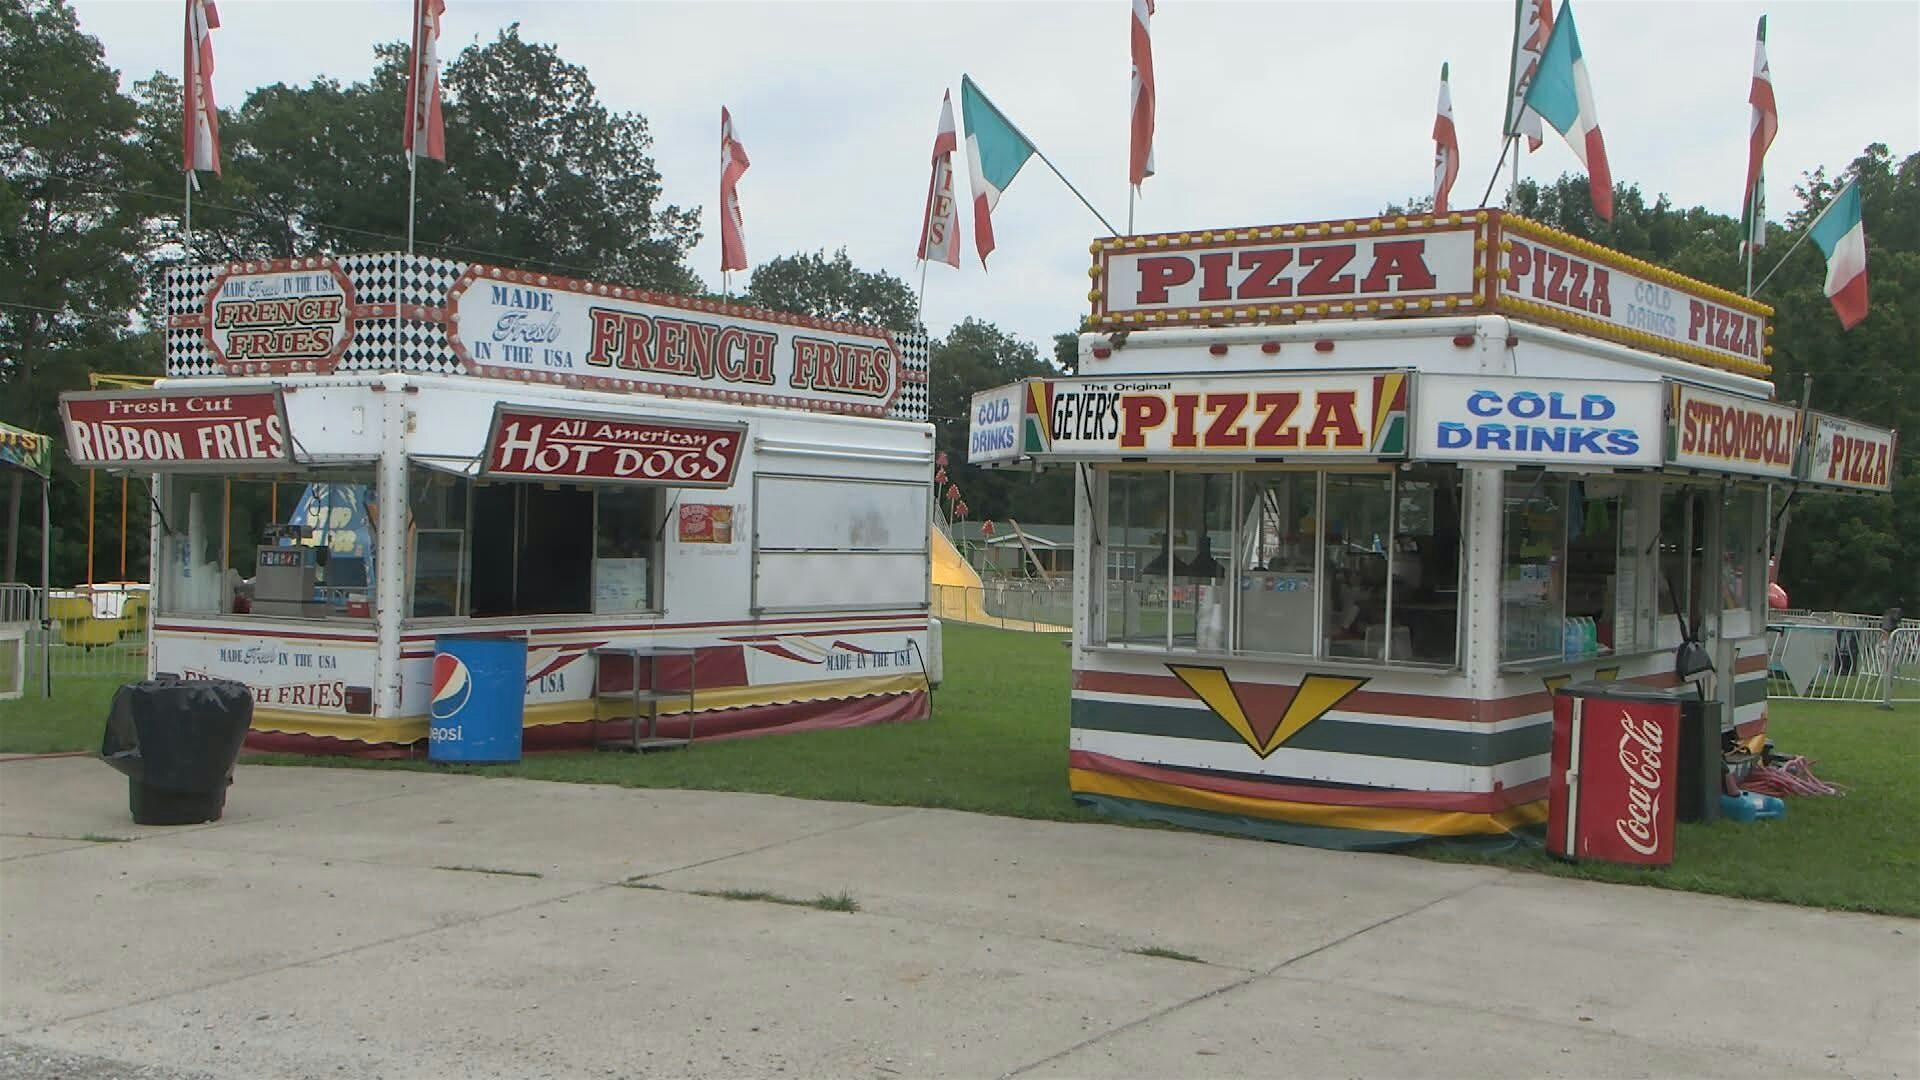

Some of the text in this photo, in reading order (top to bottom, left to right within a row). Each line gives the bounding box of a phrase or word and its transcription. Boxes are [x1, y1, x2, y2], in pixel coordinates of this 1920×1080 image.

[224, 281, 246, 297] MADE
[283, 278, 292, 294] IN
[295, 276, 312, 293] THE
[316, 274, 335, 291] USA
[1136, 239, 1436, 305] PIZZA
[1506, 238, 1611, 317] PIZZA
[216, 296, 342, 328] FRENCH
[491, 285, 553, 312] MADE
[1634, 281, 1672, 312] COLD
[492, 311, 560, 343] Fresh
[1626, 303, 1678, 338] DRINKS
[1688, 299, 1759, 358] PIZZA
[227, 327, 333, 358] FRIES
[475, 341, 573, 368] IN THE USA
[587, 307, 891, 398] FRENCH FRIES
[1081, 382, 1171, 392] The Original
[108, 396, 232, 414] Fresh Cut
[978, 398, 1010, 426] COLD
[1052, 391, 1366, 448] GEYER'S PIZZA
[1466, 390, 1616, 421] COLD
[72, 414, 284, 460] RIBBON FRIES
[551, 421, 707, 445] All American
[972, 425, 1014, 453] DRINKS
[1437, 421, 1640, 456] DRINKS
[1681, 399, 1794, 465] STROMBOLI
[500, 422, 730, 480] HOT DOGS
[1827, 434, 1888, 485] PIZZA
[220, 648, 243, 663] MADE
[279, 653, 288, 666] IN
[295, 653, 313, 668] THE
[318, 655, 337, 669] USA
[827, 654, 851, 671] MADE
[873, 652, 889, 668] THE
[895, 650, 911, 667] USA
[278, 681, 344, 709] FRIES
[540, 672, 565, 694] USA
[430, 726, 463, 744] epsi
